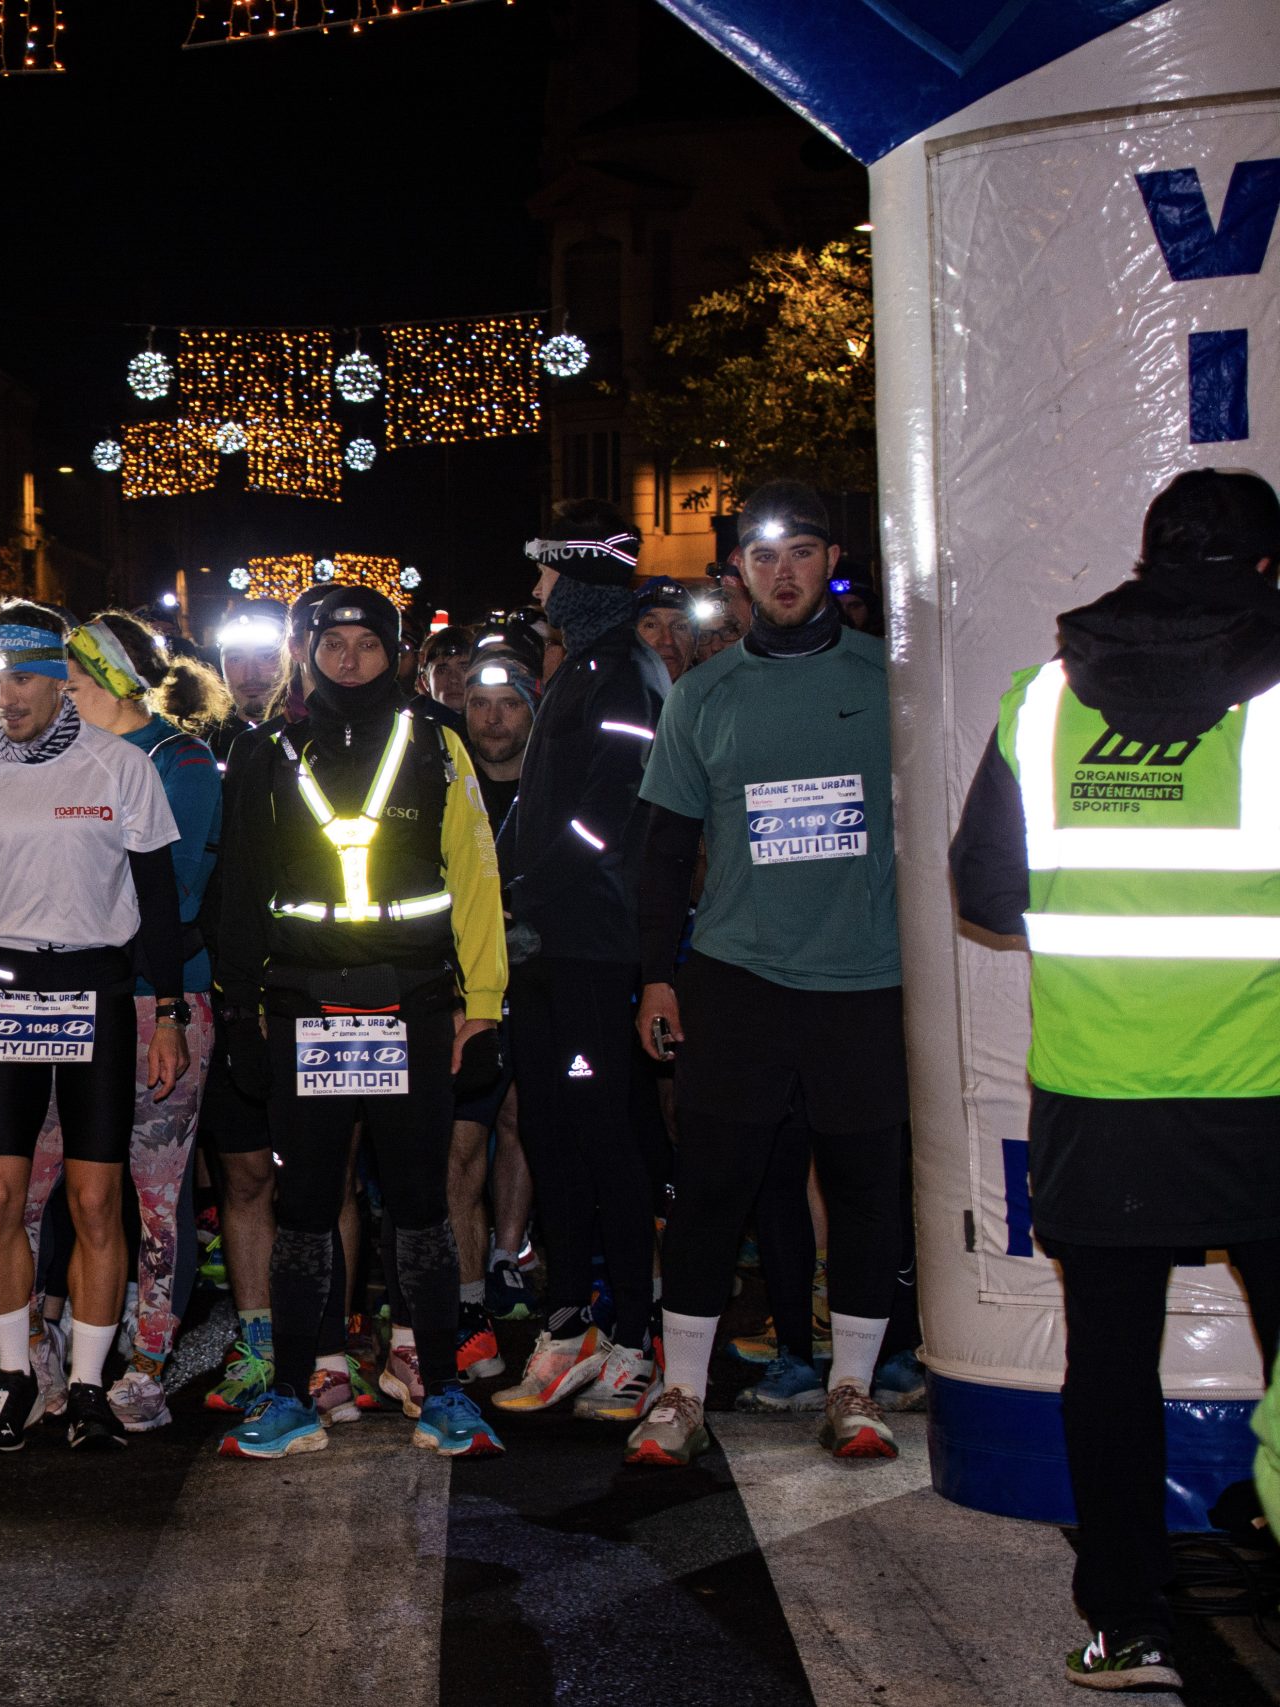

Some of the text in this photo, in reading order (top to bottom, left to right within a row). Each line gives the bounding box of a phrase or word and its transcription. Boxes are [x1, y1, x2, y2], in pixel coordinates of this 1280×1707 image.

[1074, 770, 1183, 783] ORGANISATION
[752, 779, 855, 796] ROANNE TRAIL URBAIN
[1073, 784, 1181, 799] D'ÉVÉNEMENTS
[54, 806, 99, 816] roannais
[1072, 801, 1140, 813] SPORTIFS
[788, 815, 826, 828] 1190
[757, 834, 859, 857] HYUNDAI
[26, 1023, 59, 1033] 1048
[334, 1051, 370, 1062] 1074
[304, 1073, 399, 1088] HYUNDAI
